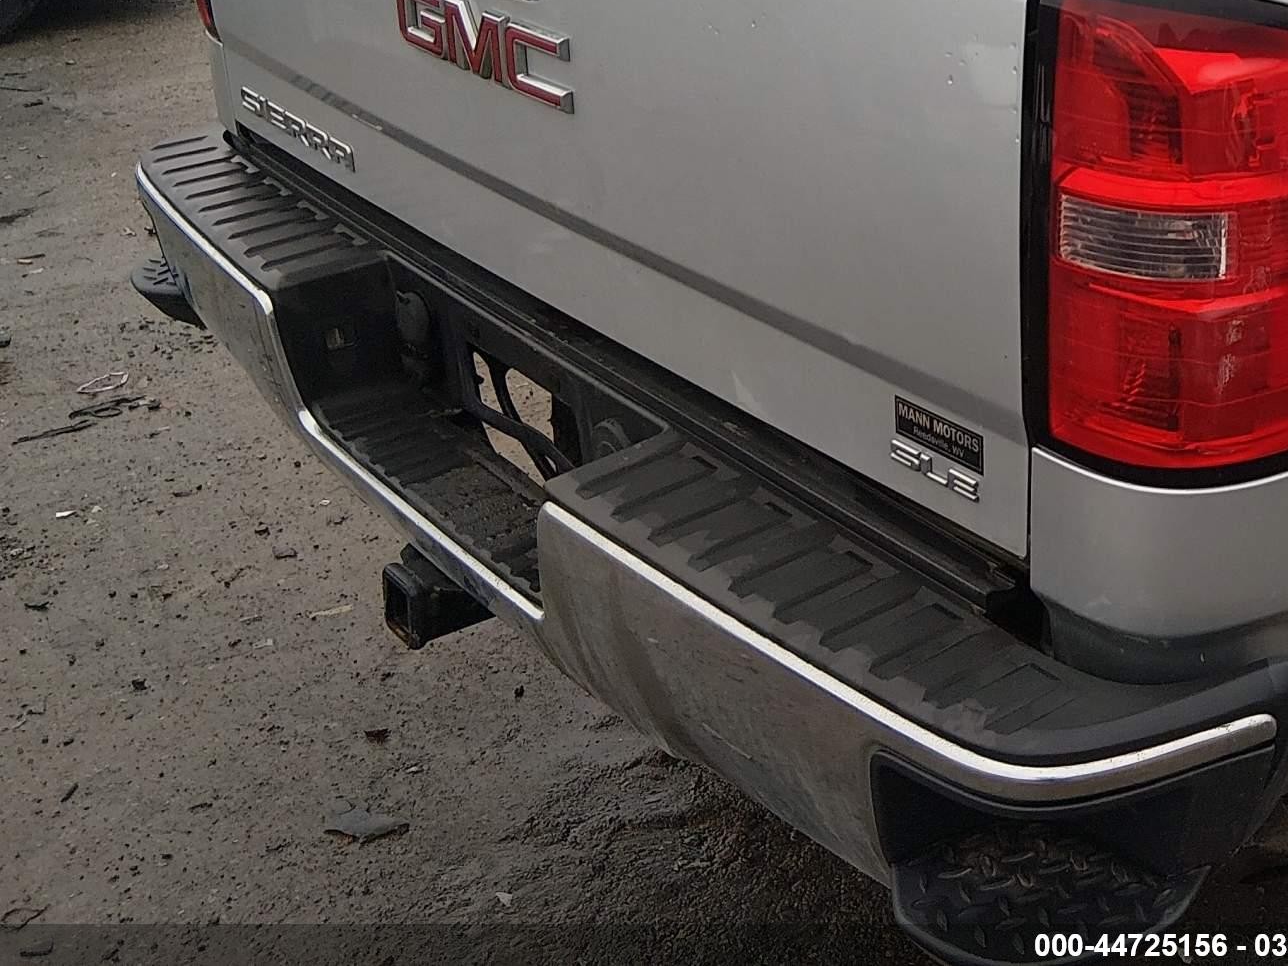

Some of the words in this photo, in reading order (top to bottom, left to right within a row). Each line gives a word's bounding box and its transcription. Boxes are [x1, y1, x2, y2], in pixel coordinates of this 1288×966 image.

[241, 85, 355, 173] SIERRA
[898, 402, 930, 430] MANN
[933, 419, 979, 452] MOTORS
[890, 439, 980, 503] SLE
